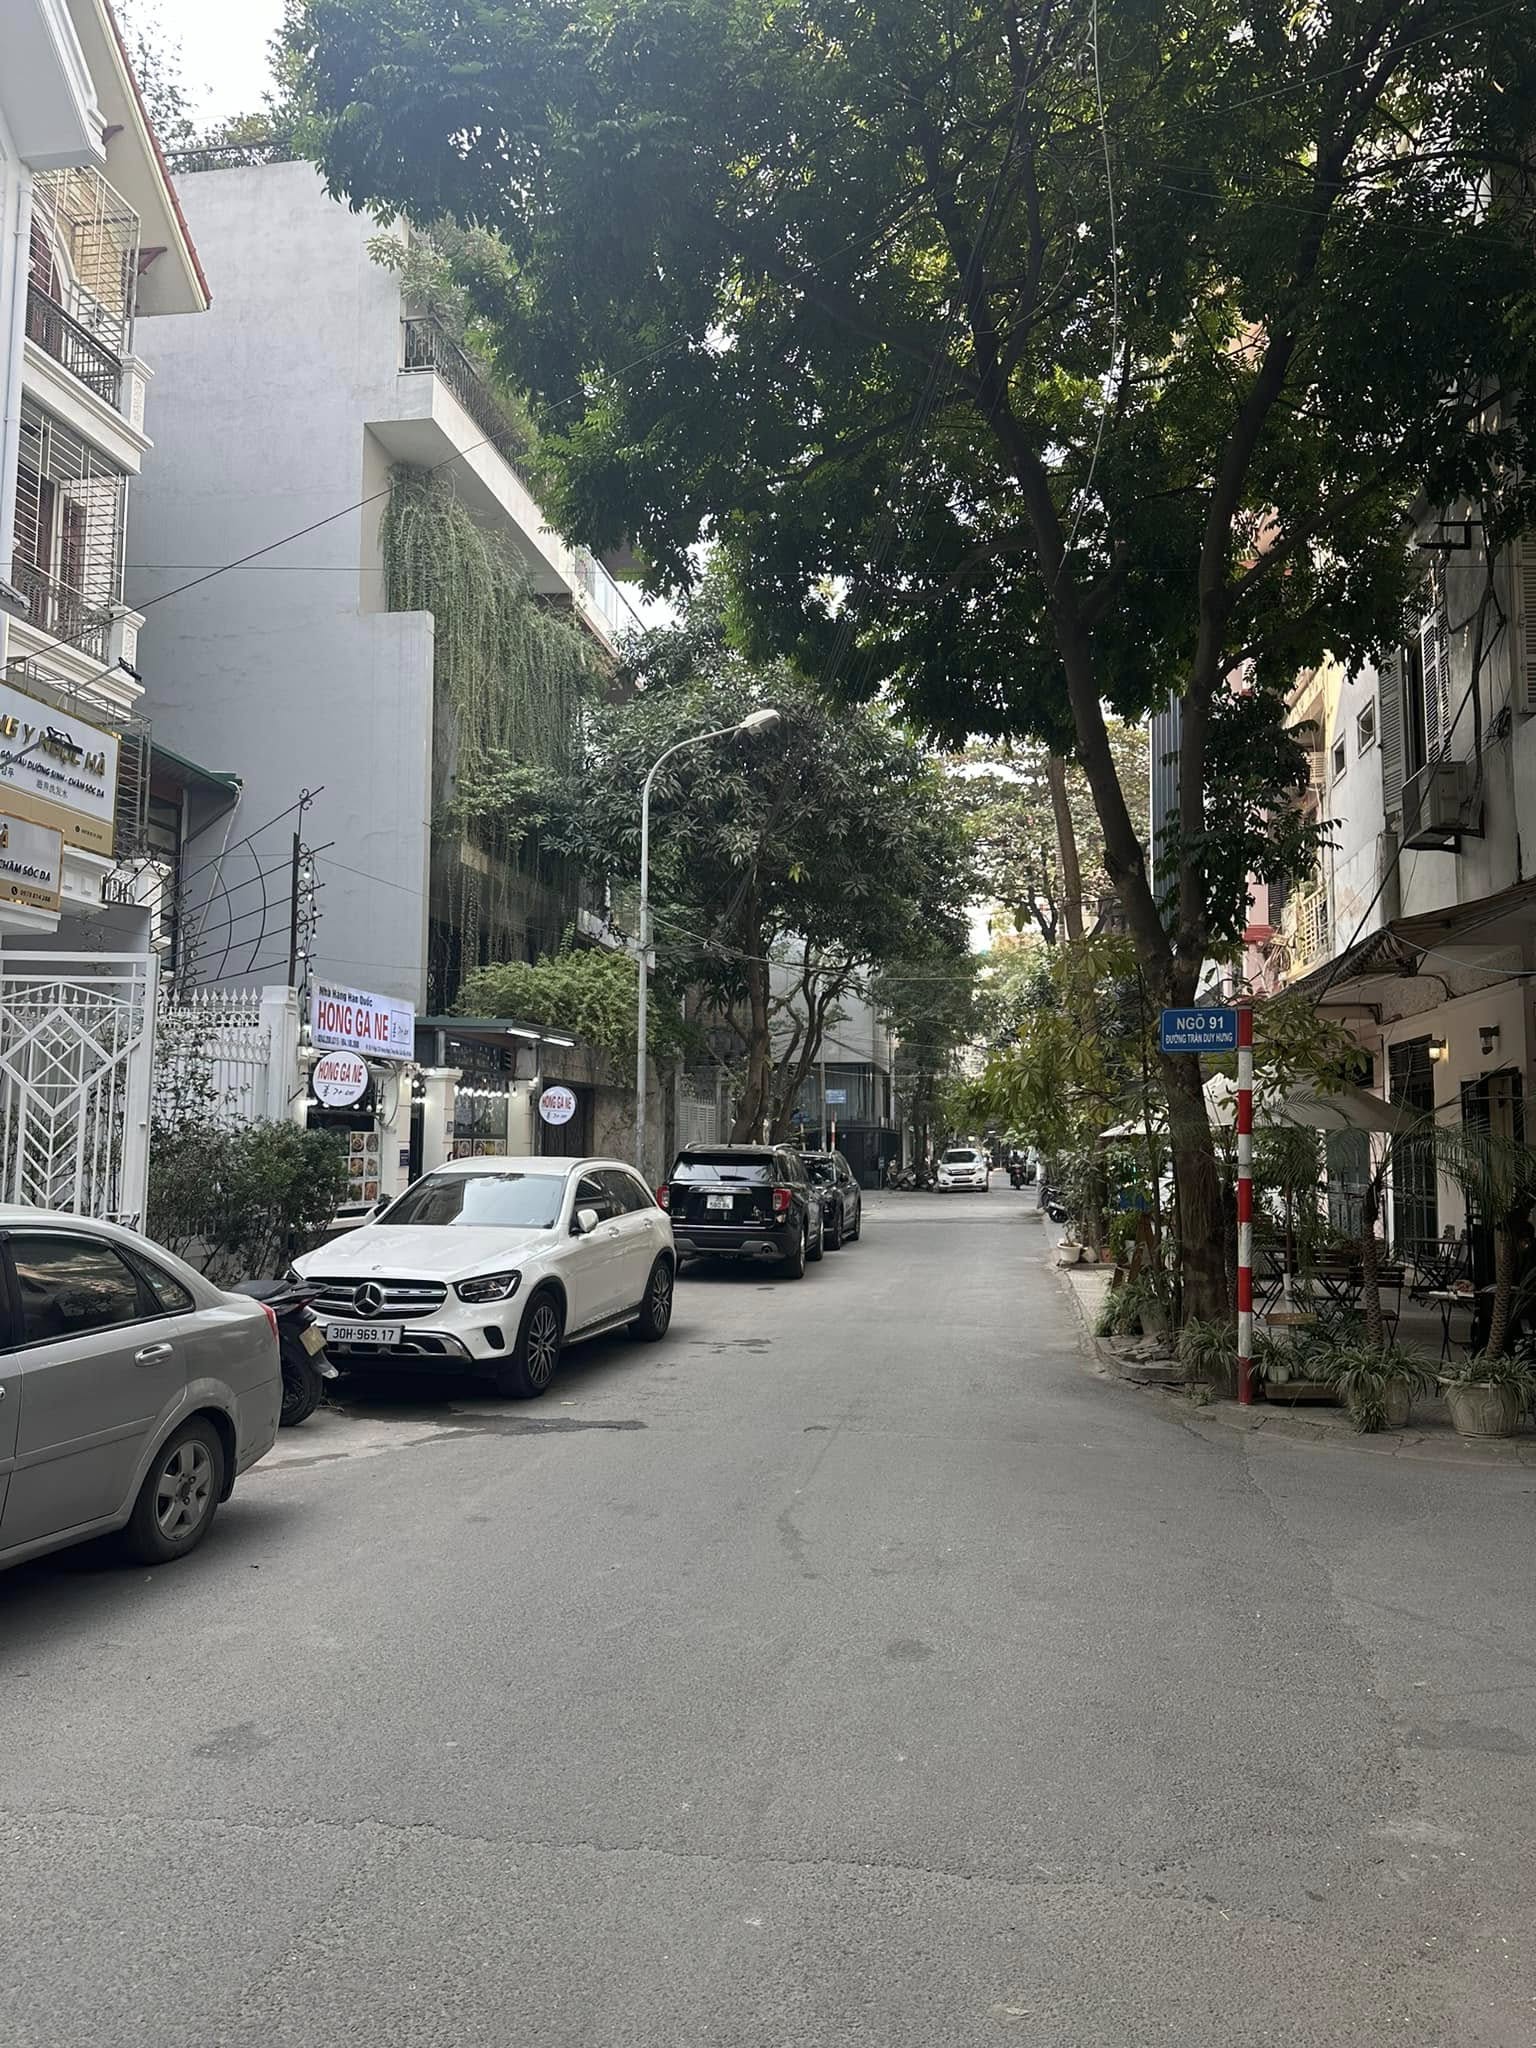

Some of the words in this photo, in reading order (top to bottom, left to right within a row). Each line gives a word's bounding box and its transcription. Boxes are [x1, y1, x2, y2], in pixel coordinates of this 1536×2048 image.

[23, 723, 36, 744] Y
[23, 864, 40, 879] SÓC
[40, 870, 51, 882] DA
[318, 1000, 352, 1035] HONG
[355, 1008, 371, 1039] GA
[374, 1013, 388, 1041] NE
[1177, 1014, 1205, 1030] NGÕ
[1209, 1016, 1223, 1029] 91
[1203, 1033, 1215, 1043] DUY
[318, 1061, 339, 1081] HONG
[340, 1063, 351, 1082] GA
[352, 1064, 363, 1083] NE
[543, 1095, 556, 1109] HONG
[557, 1096, 564, 1109] GA
[564, 1096, 572, 1110] NE
[332, 1327, 394, 1341] 30H-969.17
